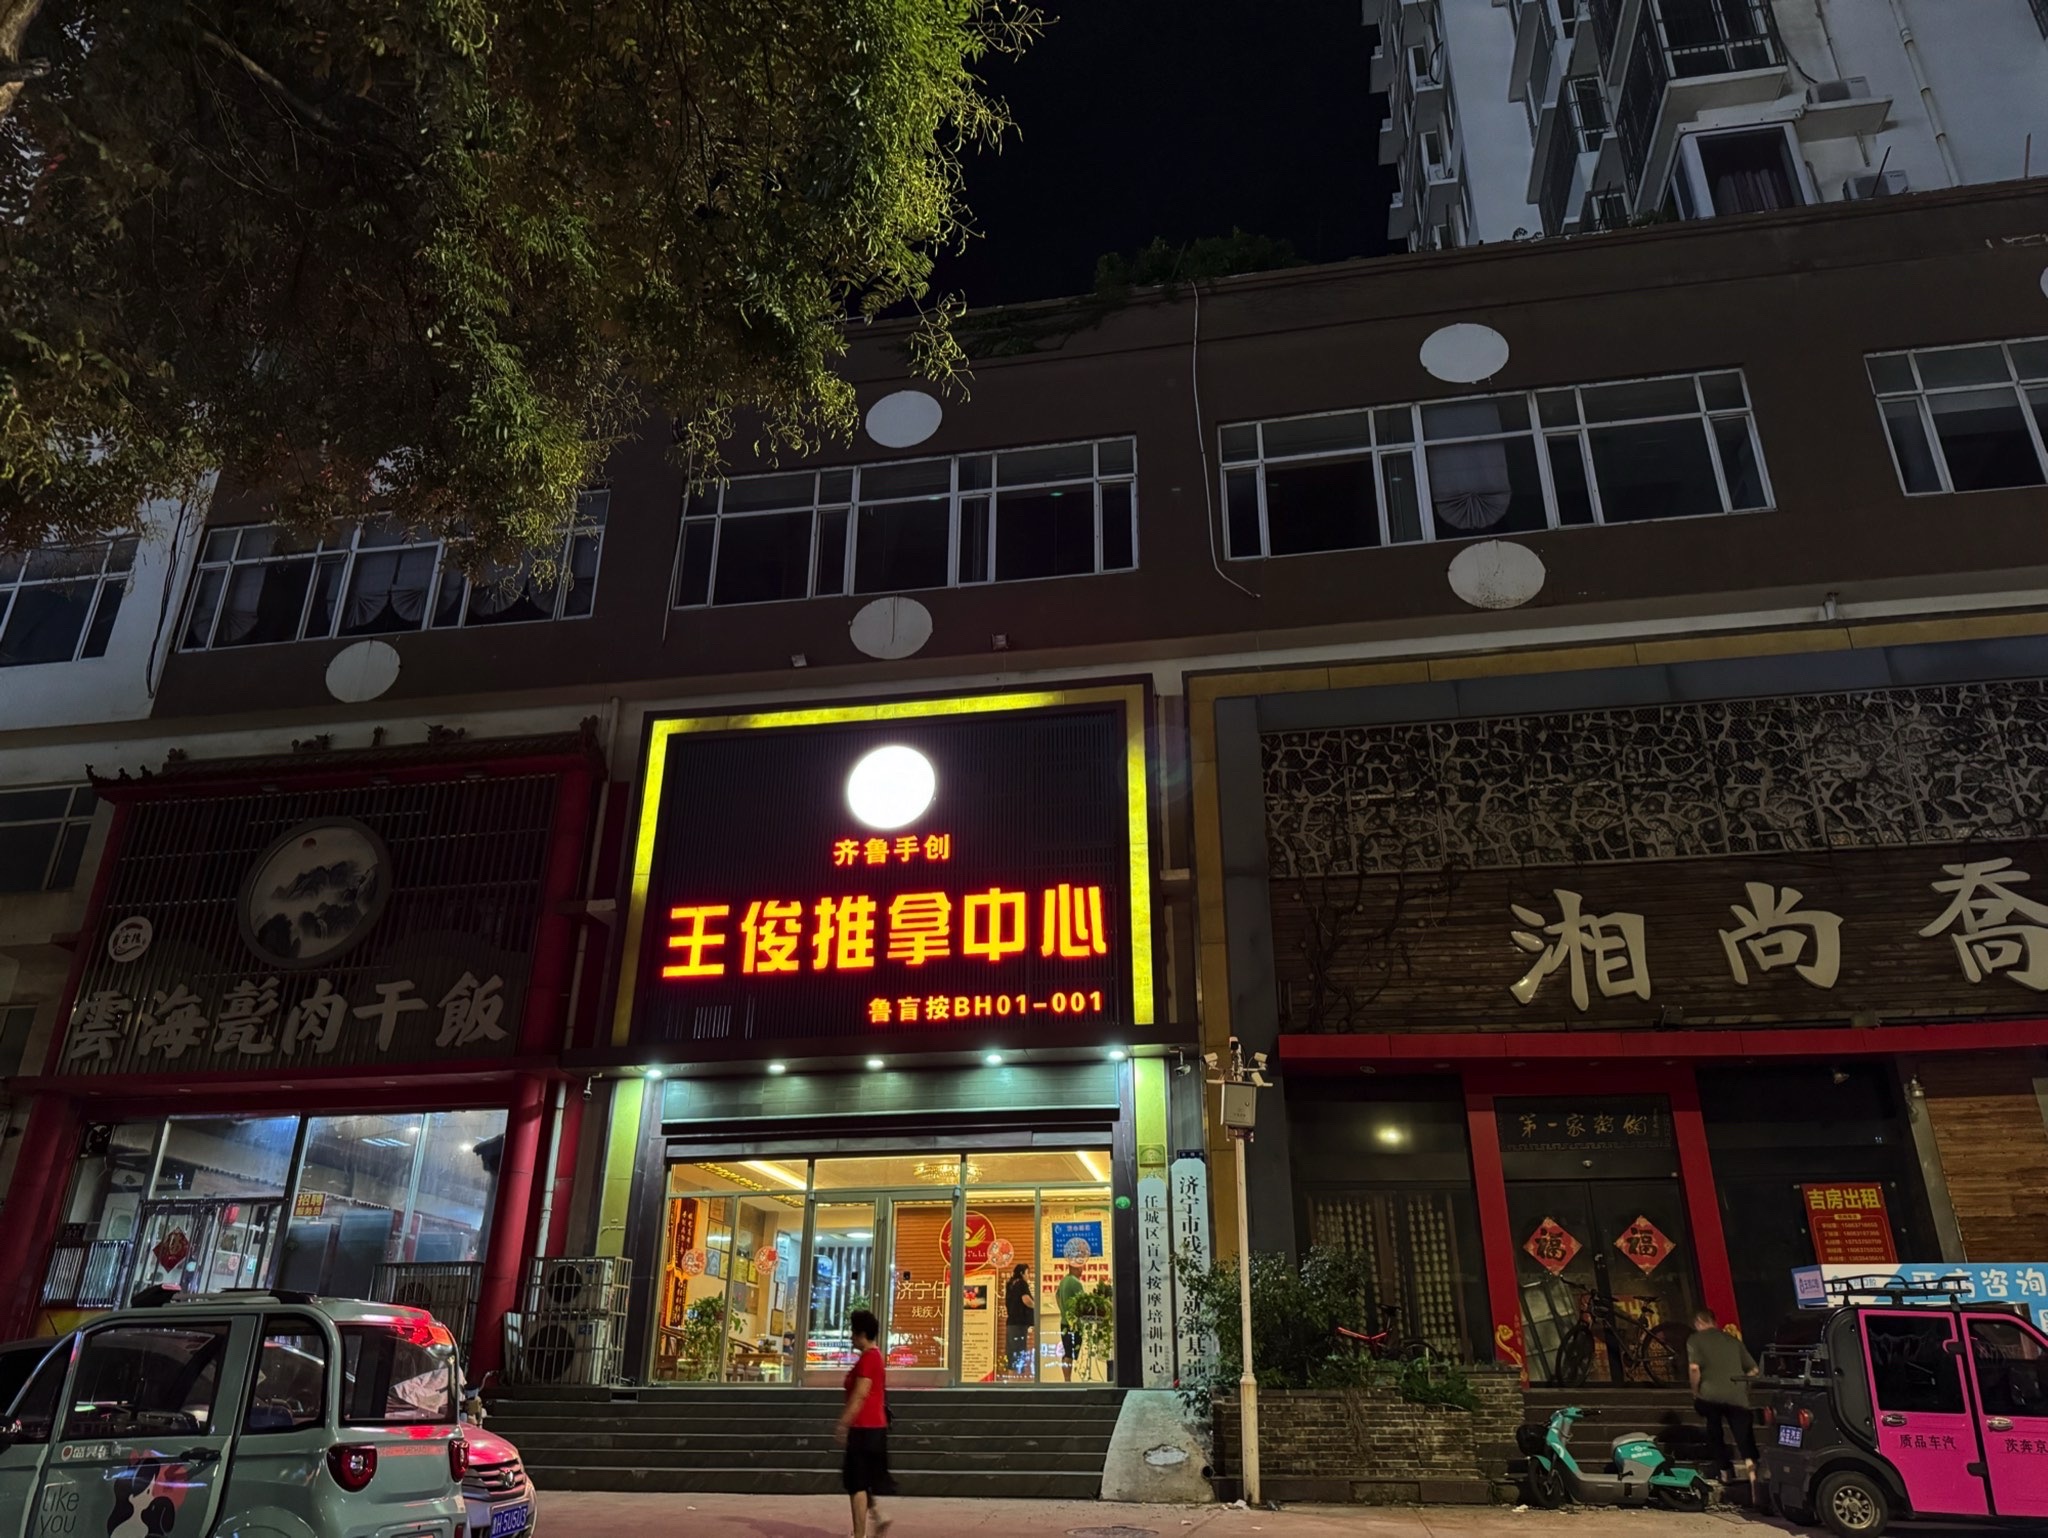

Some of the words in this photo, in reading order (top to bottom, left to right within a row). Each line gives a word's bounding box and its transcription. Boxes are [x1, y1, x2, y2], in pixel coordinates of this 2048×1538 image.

[833, 834, 951, 866] 齐鲁手创
[661, 882, 1107, 978] 王俊推拿中心
[868, 991, 1103, 1024] 鲁盲按BH01-001
[297, 1193, 324, 1206] 招聘
[1807, 1188, 1881, 1210] 吉房出租
[1535, 1228, 1566, 1261] 福
[1626, 1227, 1659, 1257] 福
[1144, 1195, 1165, 1374] 任城区盲人按摩培训中心
[911, 1306, 944, 1318] 残疾人
[40, 1514, 77, 1538] you
